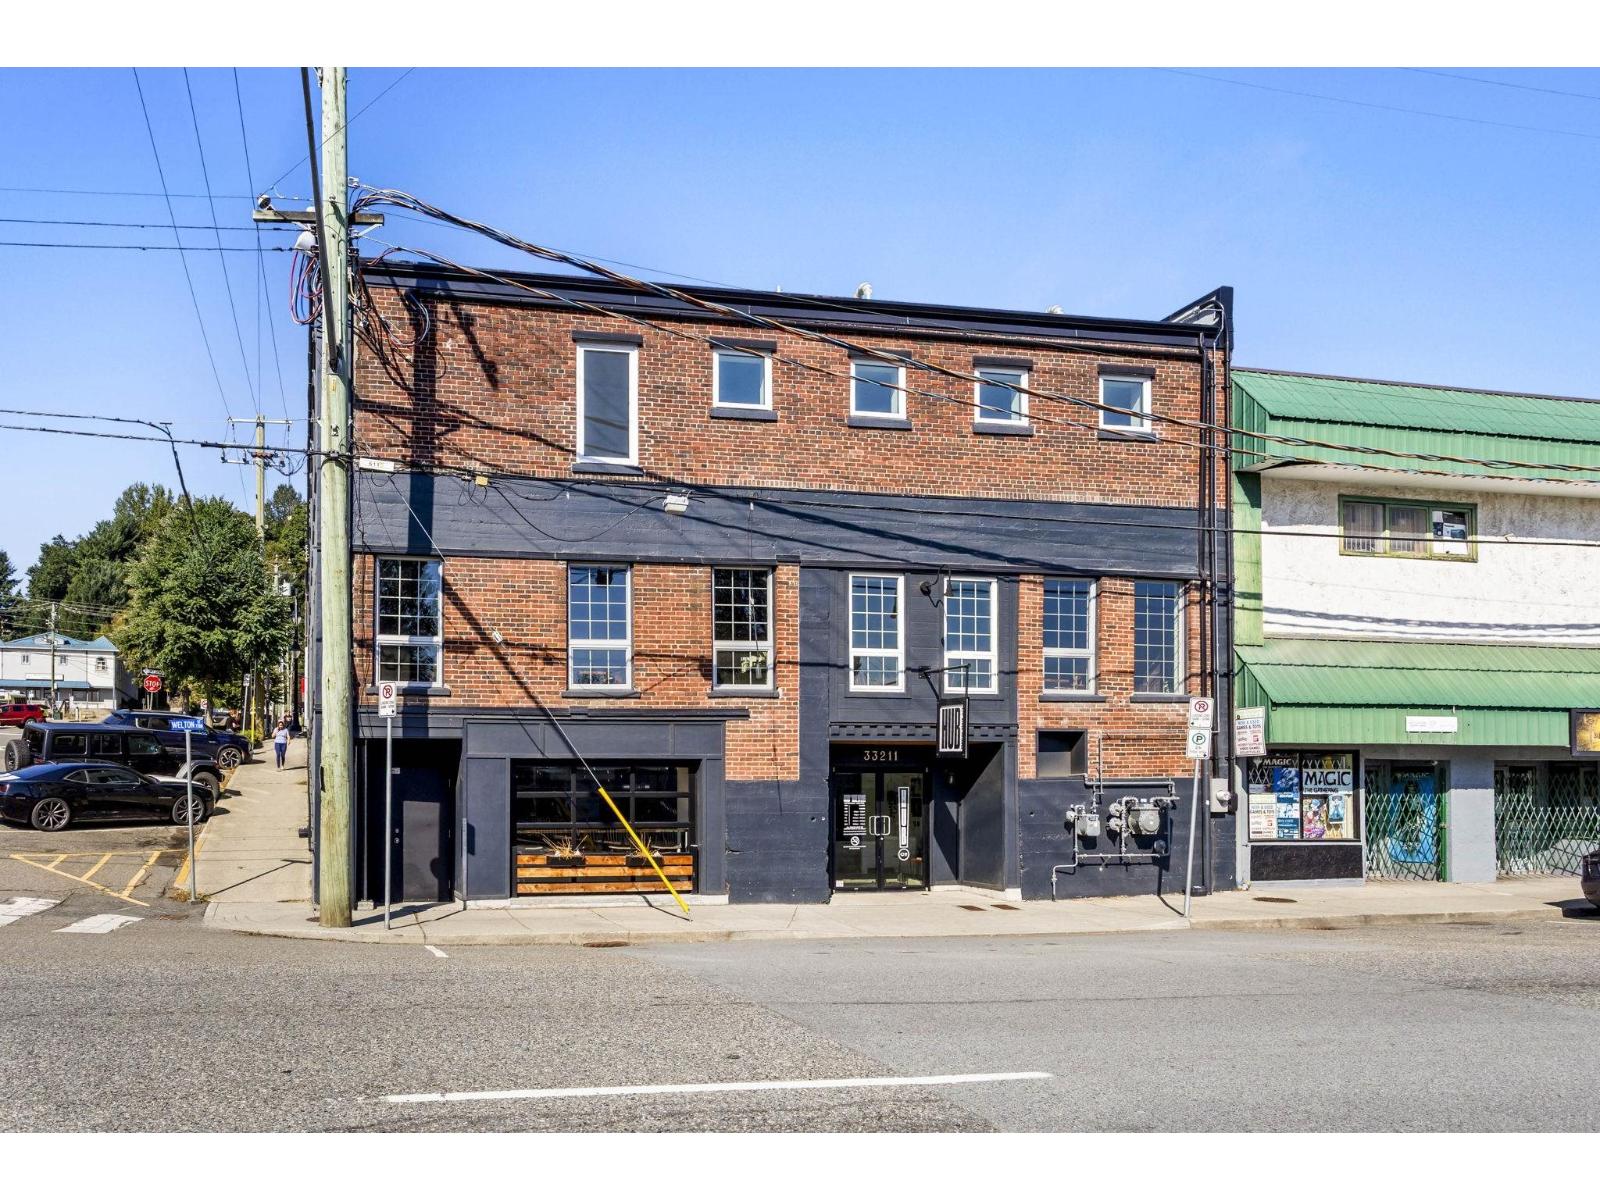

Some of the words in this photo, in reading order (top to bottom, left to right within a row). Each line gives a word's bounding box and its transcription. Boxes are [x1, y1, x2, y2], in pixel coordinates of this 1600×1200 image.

[145, 680, 159, 688] STOP
[171, 721, 195, 729] WELTON
[941, 707, 961, 750] HUB
[863, 750, 899, 761] 33211
[1262, 758, 1292, 766] MAGIC
[1304, 771, 1351, 786] MAGIC
